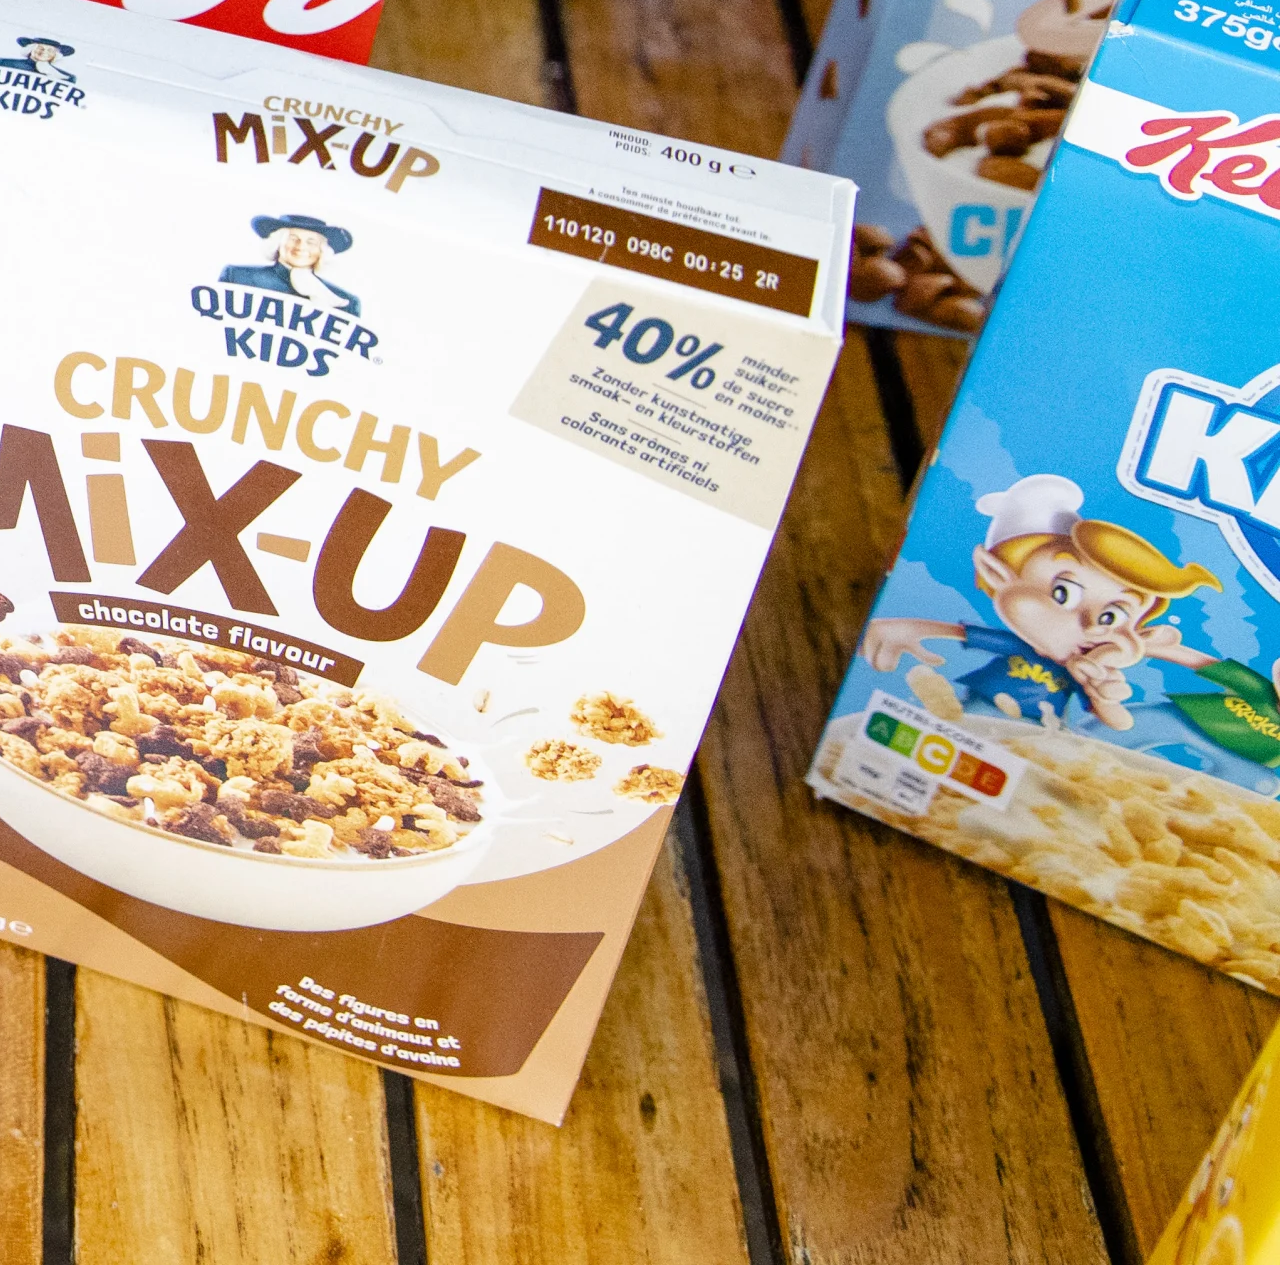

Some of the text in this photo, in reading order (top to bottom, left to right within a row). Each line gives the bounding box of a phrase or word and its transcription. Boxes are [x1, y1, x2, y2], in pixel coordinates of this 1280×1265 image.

[1173, 0, 1274, 51] 375g
[263, 95, 405, 134] CRUNCHY
[212, 110, 441, 195] MiX-UP
[659, 145, 702, 167] 400
[543, 214, 780, 291] 110120 098C 00:25 2R
[190, 284, 380, 362] QUAKER
[223, 326, 339, 377] KIDS
[584, 301, 725, 391] 40%
[714, 391, 735, 407] en
[721, 377, 795, 418] de sucre
[740, 354, 800, 386] minder
[53, 350, 483, 502] CRUNCHY
[568, 372, 761, 466] smaak- en kleurstoffen
[591, 365, 754, 447] Zonder kunstmatige
[560, 414, 720, 494] colorants artificiels
[588, 410, 709, 473] Sans arômes ni
[77, 599, 338, 674] chocolate flavour
[268, 998, 462, 1069] des pépites d'avoine
[275, 983, 462, 1051] forme d'animaux et
[298, 975, 439, 1031] Des figures en
